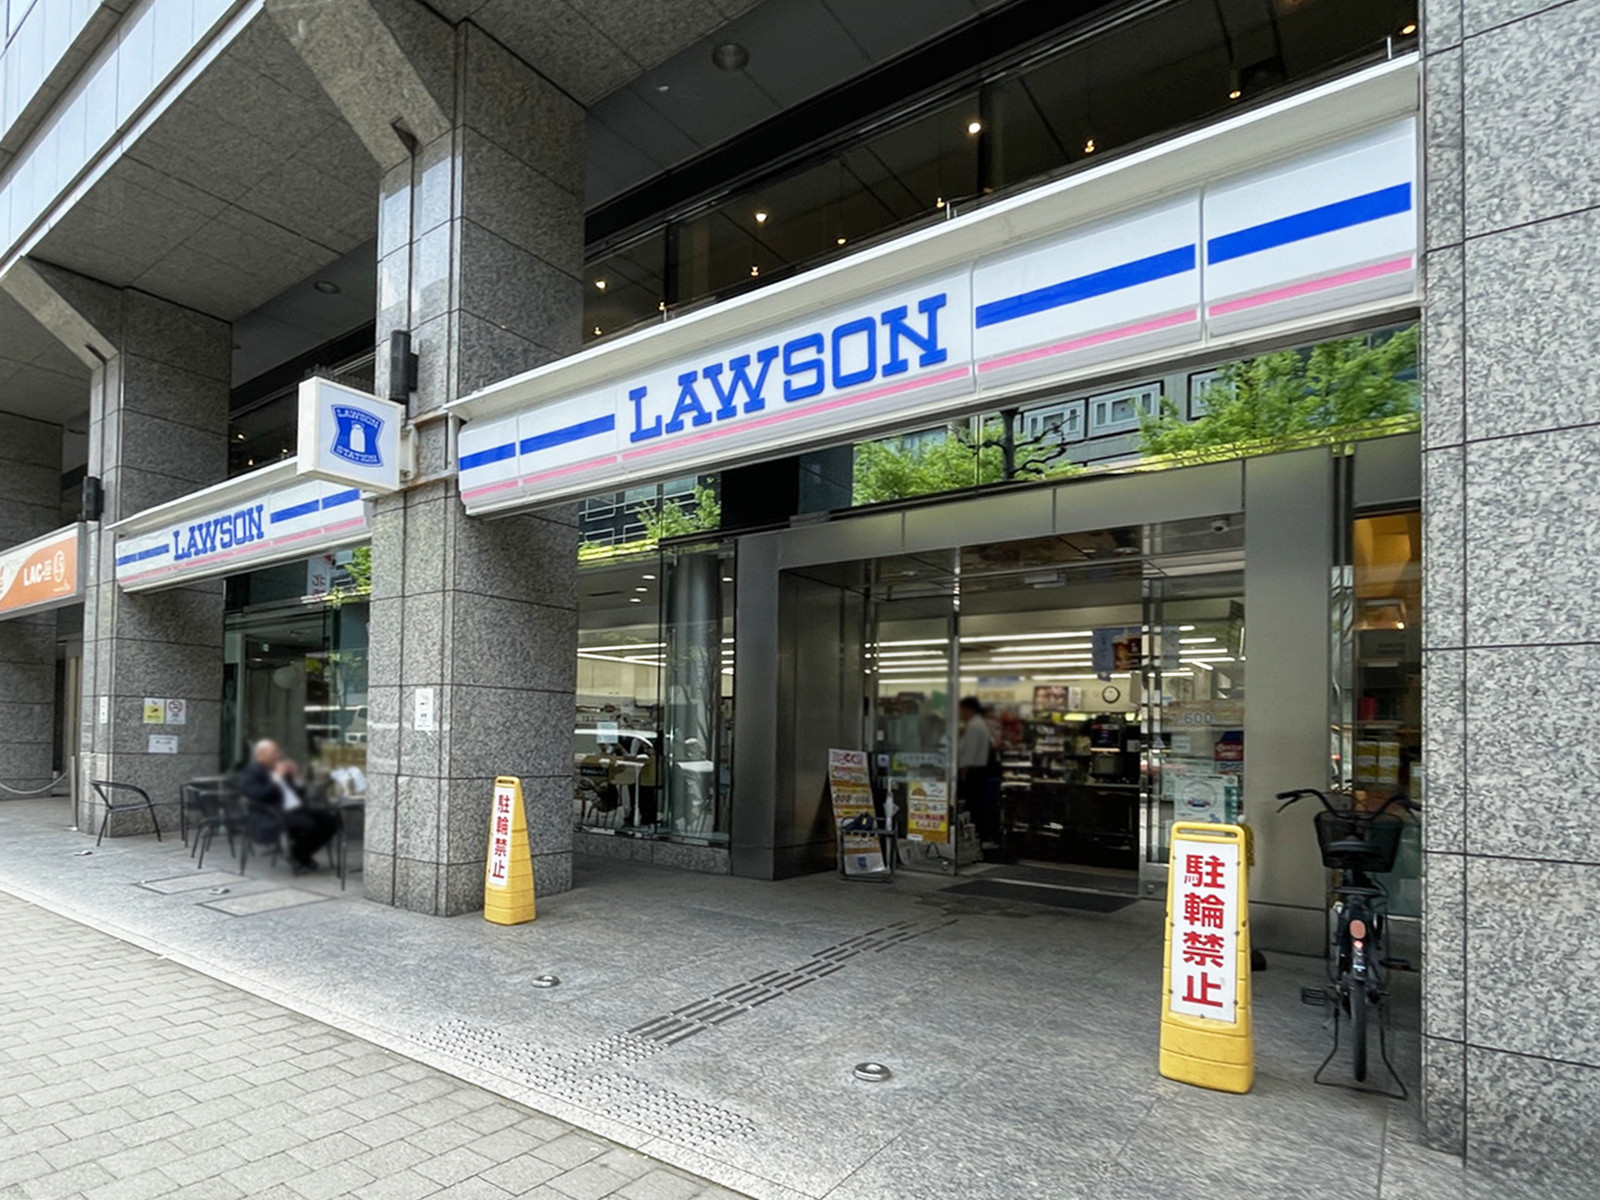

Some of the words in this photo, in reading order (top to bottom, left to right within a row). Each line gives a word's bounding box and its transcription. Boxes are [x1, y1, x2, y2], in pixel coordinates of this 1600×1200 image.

[628, 293, 948, 442] LAWSON
[335, 444, 379, 463] STATION
[336, 408, 380, 429] LAWSON
[173, 504, 264, 561] LAWSON
[493, 794, 511, 879] 駐輪禁止
[1181, 854, 1226, 1009] 駐輪禁止
